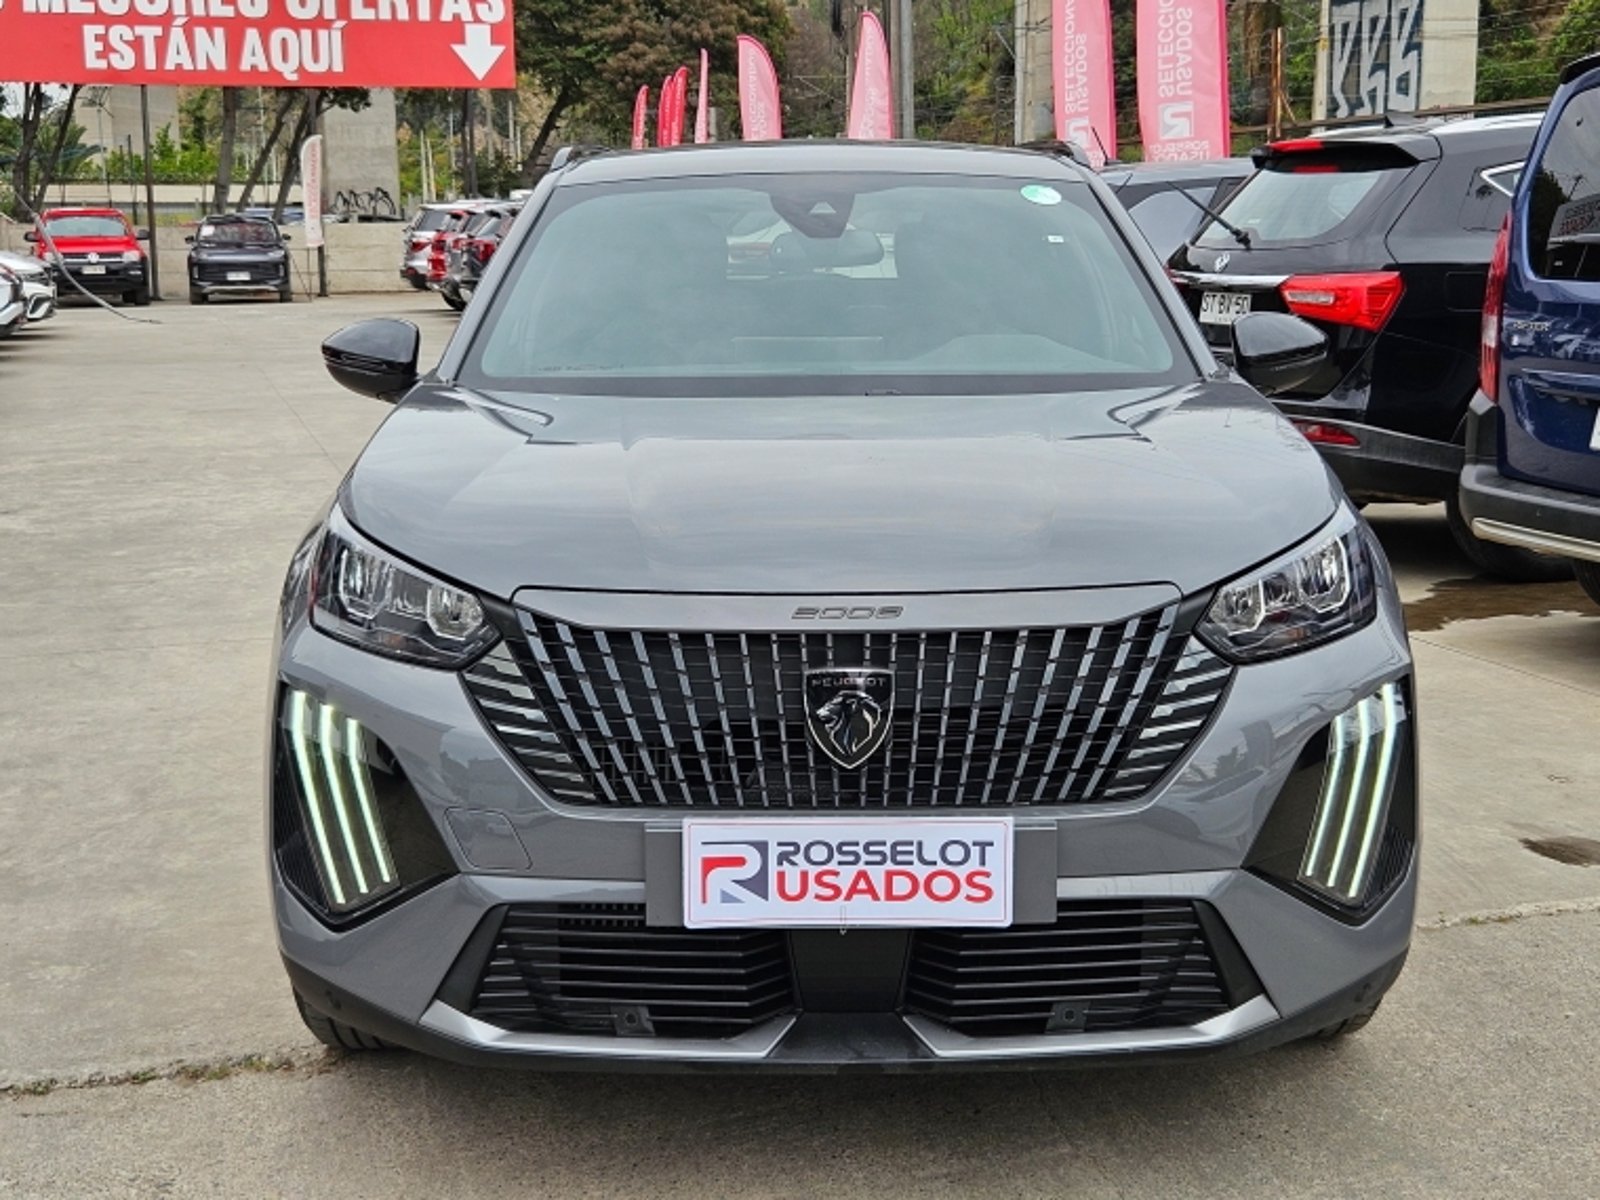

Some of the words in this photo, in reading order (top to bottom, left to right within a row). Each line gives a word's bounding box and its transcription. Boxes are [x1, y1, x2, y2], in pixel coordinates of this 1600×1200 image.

[82, 17, 227, 71] ESTÁN
[239, 20, 348, 81] AQUÍ
[776, 840, 995, 867] ROSSELOT
[776, 869, 995, 903] USADOS
